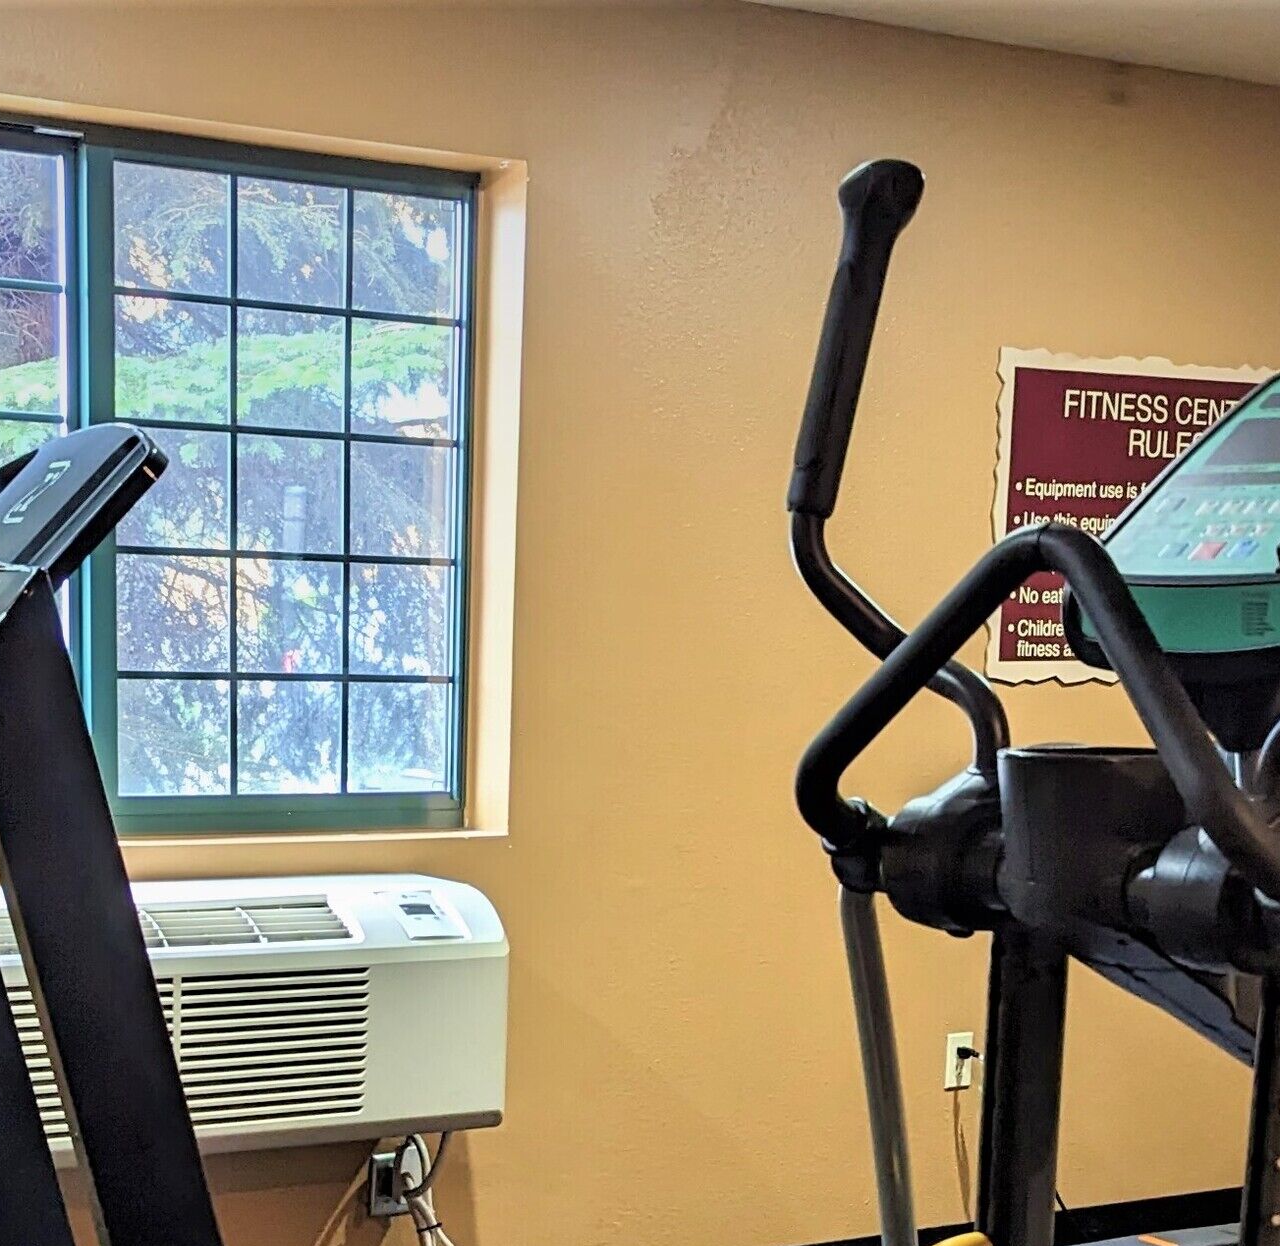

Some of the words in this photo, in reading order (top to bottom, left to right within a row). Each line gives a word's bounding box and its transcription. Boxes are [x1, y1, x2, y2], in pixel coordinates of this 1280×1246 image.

[1063, 388, 1169, 424] FITNESS
[1128, 428, 1203, 459] RULE
[1025, 477, 1097, 501] Equipment
[1099, 484, 1124, 499] use
[1126, 481, 1138, 499] is
[1018, 586, 1039, 604] No
[1041, 587, 1064, 604] eat
[1017, 619, 1065, 637] Childre
[1016, 639, 1061, 657] fitness
